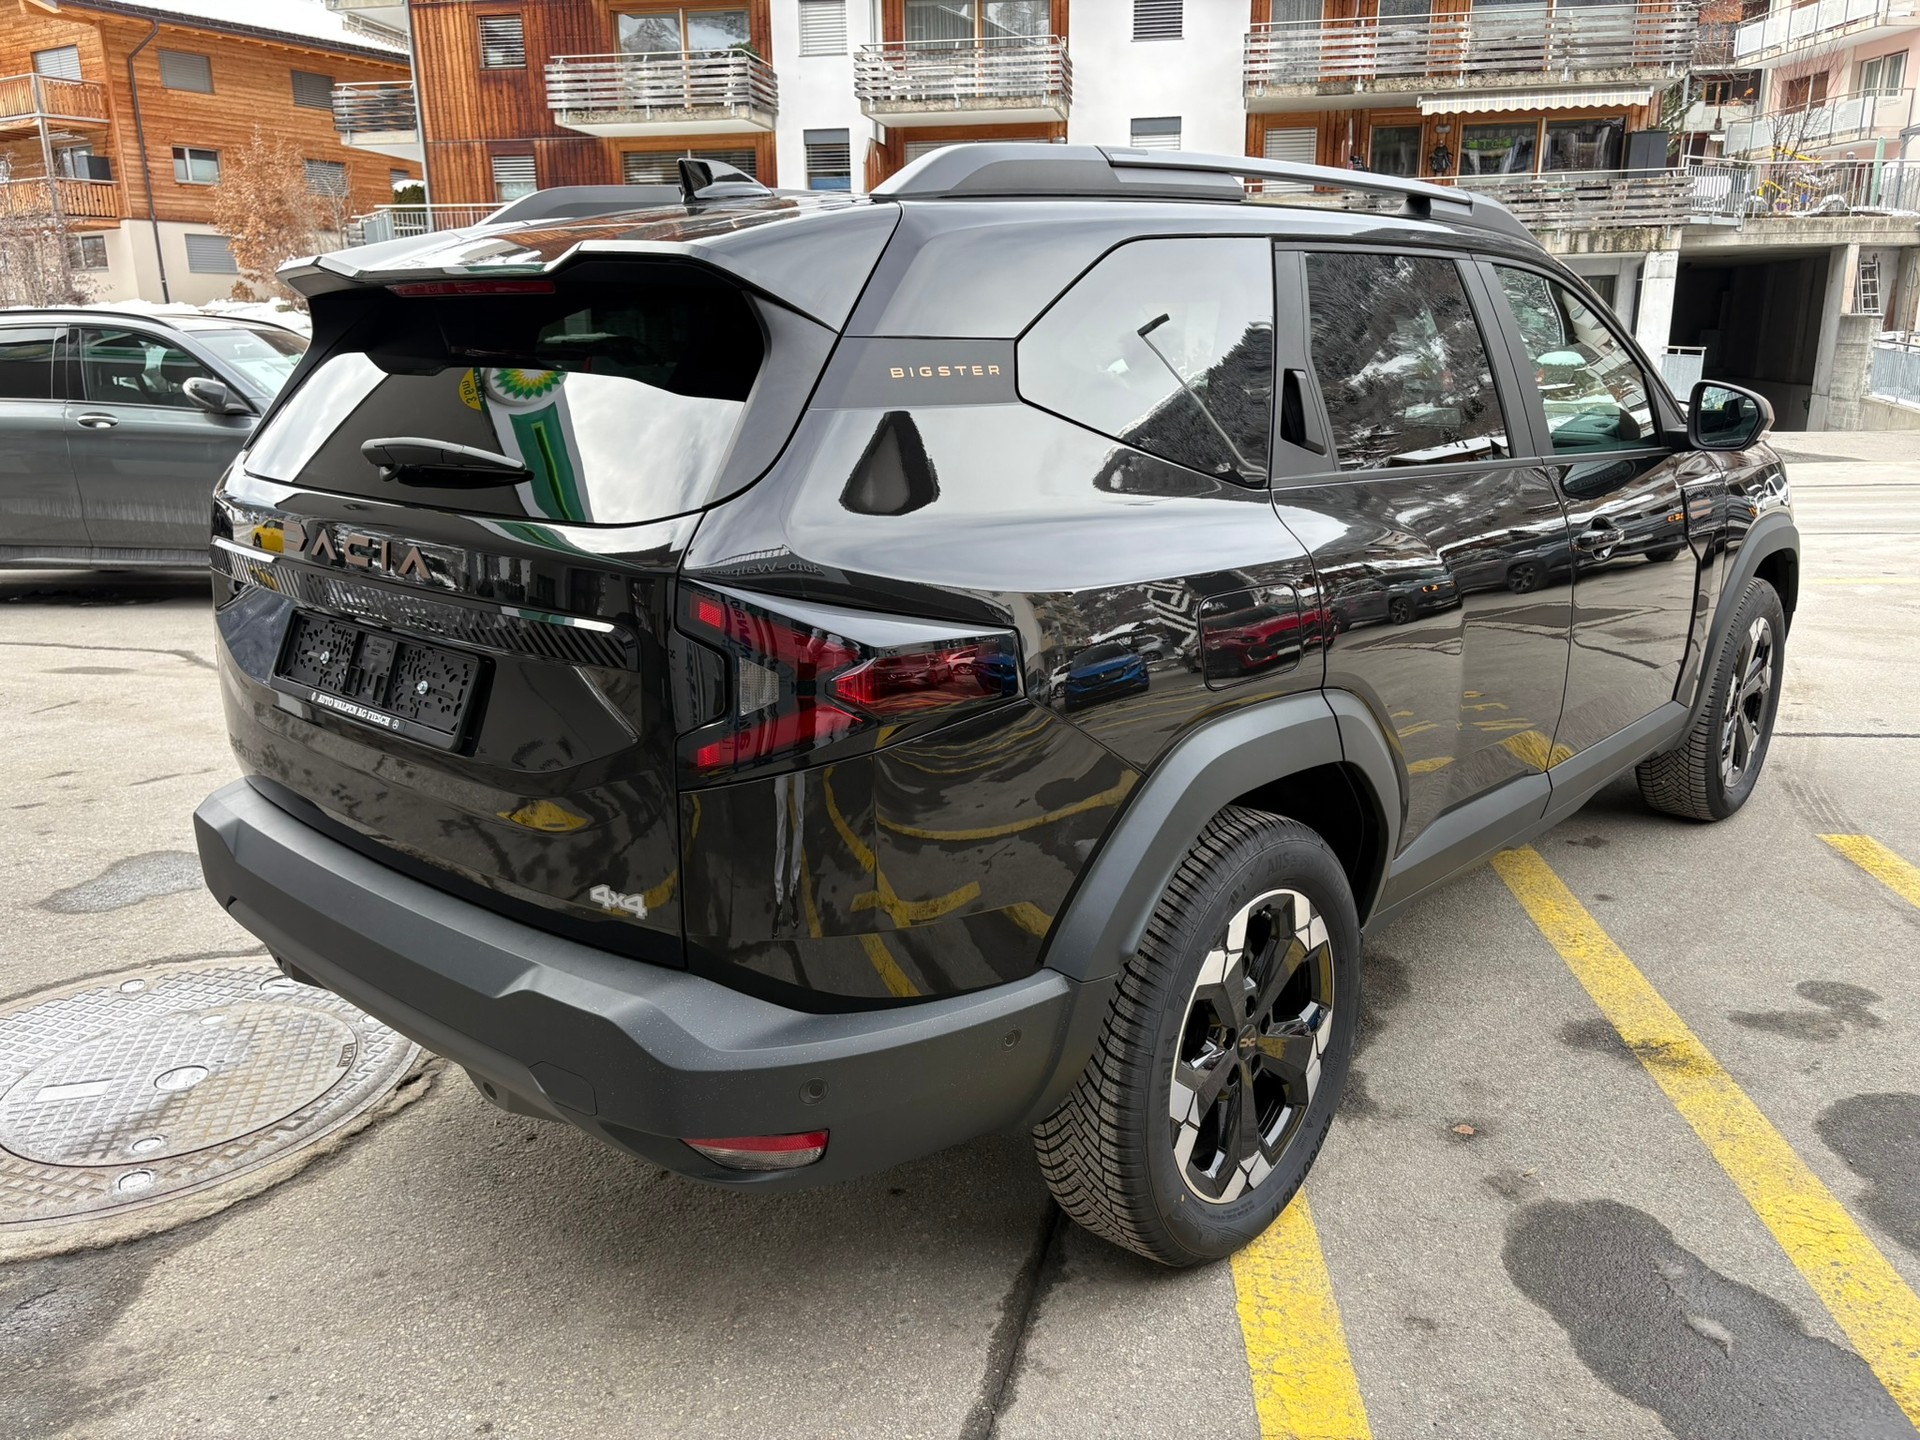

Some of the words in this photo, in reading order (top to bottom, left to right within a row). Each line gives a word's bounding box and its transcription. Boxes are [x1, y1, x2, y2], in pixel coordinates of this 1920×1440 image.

[889, 365, 1000, 379] BIGSTER
[283, 520, 433, 579] DACIA
[316, 693, 334, 707] AUTO
[333, 699, 358, 715] WALPEN
[356, 707, 368, 718] AG
[366, 711, 391, 727] FIESCH
[589, 884, 648, 920] 4x4
